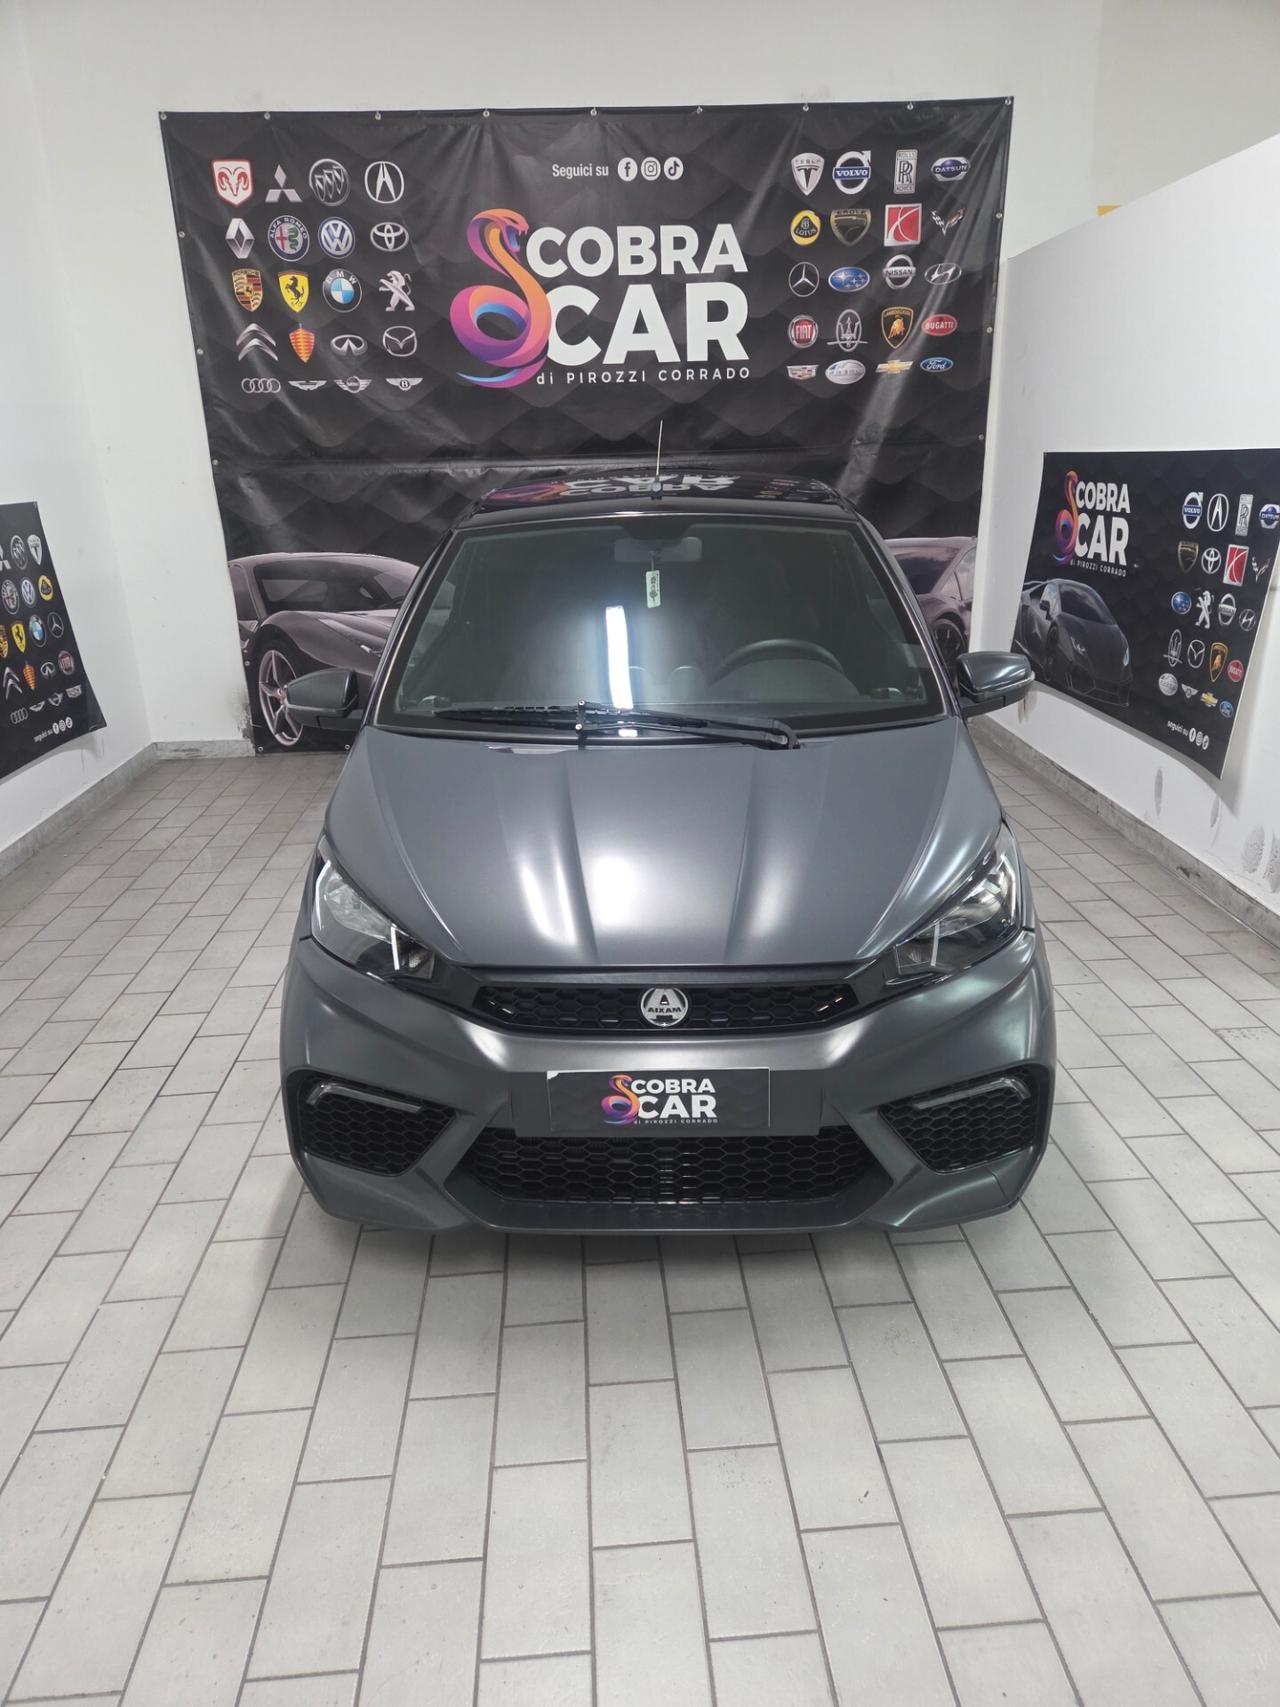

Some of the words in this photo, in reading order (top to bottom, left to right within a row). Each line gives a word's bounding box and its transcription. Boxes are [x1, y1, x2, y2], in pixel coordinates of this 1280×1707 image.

[552, 163, 593, 179] Seguici
[595, 165, 609, 177] su
[835, 169, 868, 177] VOLVO
[934, 164, 967, 173] DATSUN
[269, 219, 282, 239] ALFA
[795, 226, 817, 236] LOTUS
[526, 223, 749, 278] COBRA
[324, 269, 357, 285] BMW
[885, 268, 913, 276] NISSAN
[546, 281, 750, 367] CAR
[795, 324, 813, 340] FIAT
[925, 321, 955, 330] BUGATTI
[536, 371, 554, 385] di
[566, 370, 646, 384] PIROZZI
[658, 366, 751, 382] CORRADO
[1075, 480, 1132, 514] COBRA
[1074, 512, 1129, 566] CAR
[647, 1006, 682, 1014] AIXAM
[630, 1078, 716, 1094] COBRA
[637, 1094, 718, 1119] CAR
